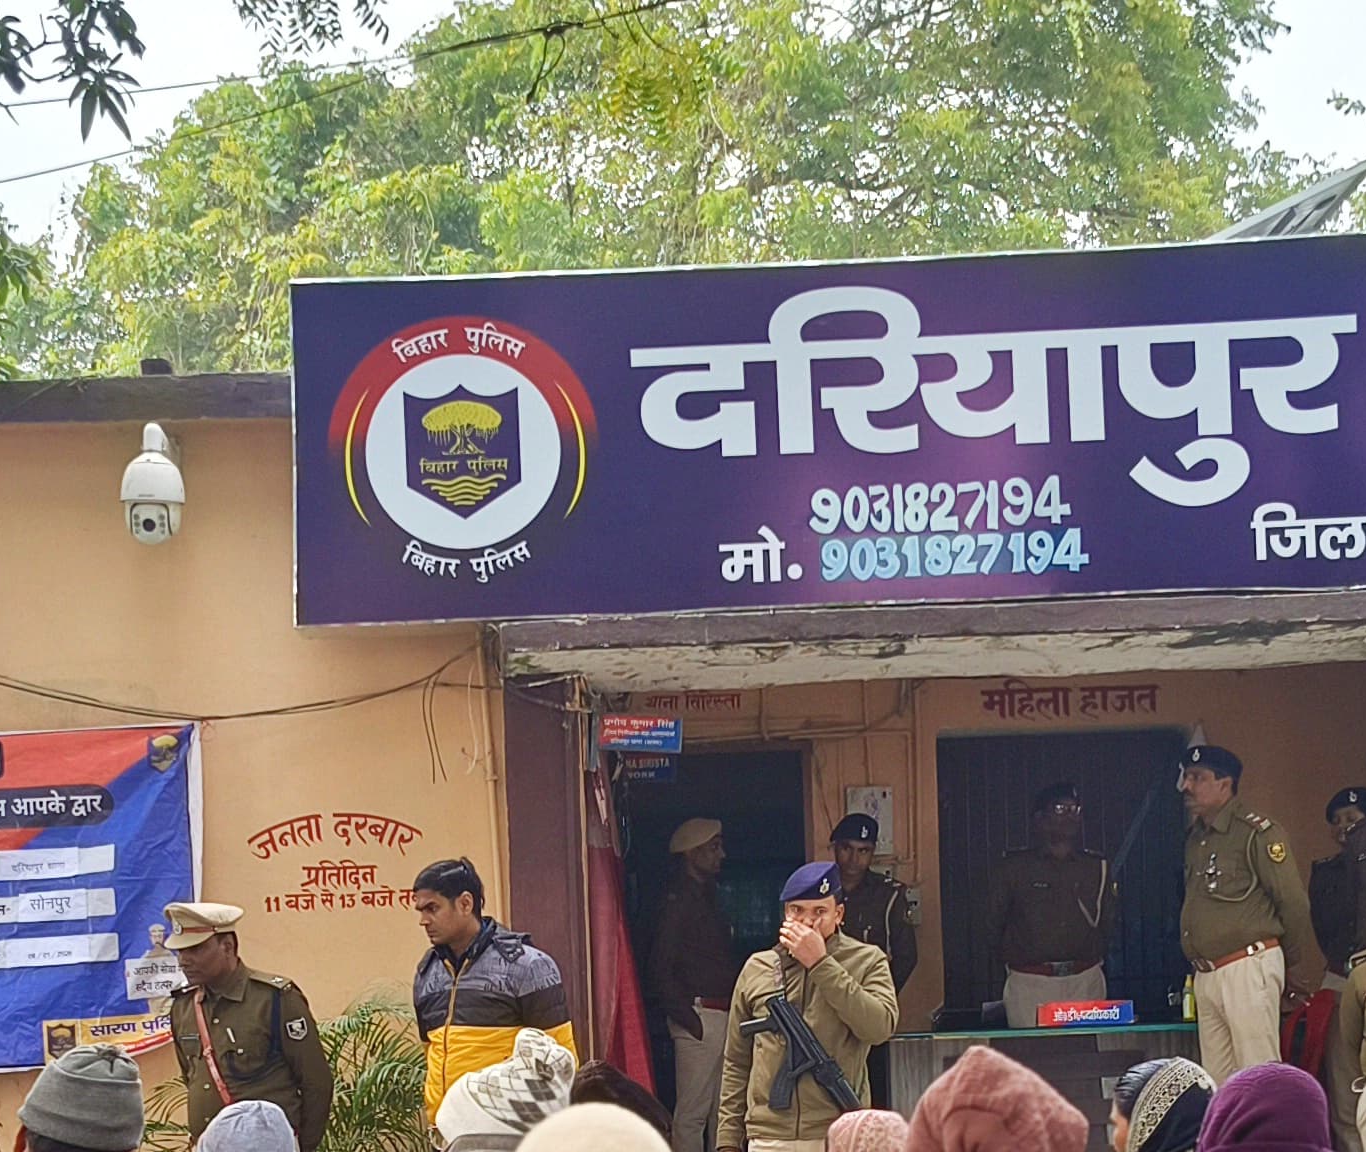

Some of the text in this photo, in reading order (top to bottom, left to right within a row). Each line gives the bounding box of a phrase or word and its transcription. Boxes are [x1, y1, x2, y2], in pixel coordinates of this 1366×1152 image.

[392, 322, 525, 362] बिहार पुलिस
[630, 286, 1357, 506] दरियापुर
[419, 457, 508, 477] बिहार पुलिस
[809, 475, 1071, 534] 9031827194
[402, 540, 531, 583] बिहार पुलिस
[719, 525, 1089, 583] मो. 9031827194
[981, 679, 1160, 721] महिला हाजत
[10, 789, 66, 817] आपके
[71, 794, 103, 817] द्वार
[247, 812, 424, 860] जनता दरबार
[300, 859, 379, 891] प्रतिदिन
[30, 894, 71, 914] सोनपुर
[265, 896, 281, 913] 11
[285, 889, 317, 912] बजे
[321, 889, 336, 912] से
[339, 894, 356, 909] 13
[361, 886, 396, 909] बजे
[133, 963, 158, 976] आपकी
[90, 1014, 172, 1037] सारण पुलि
